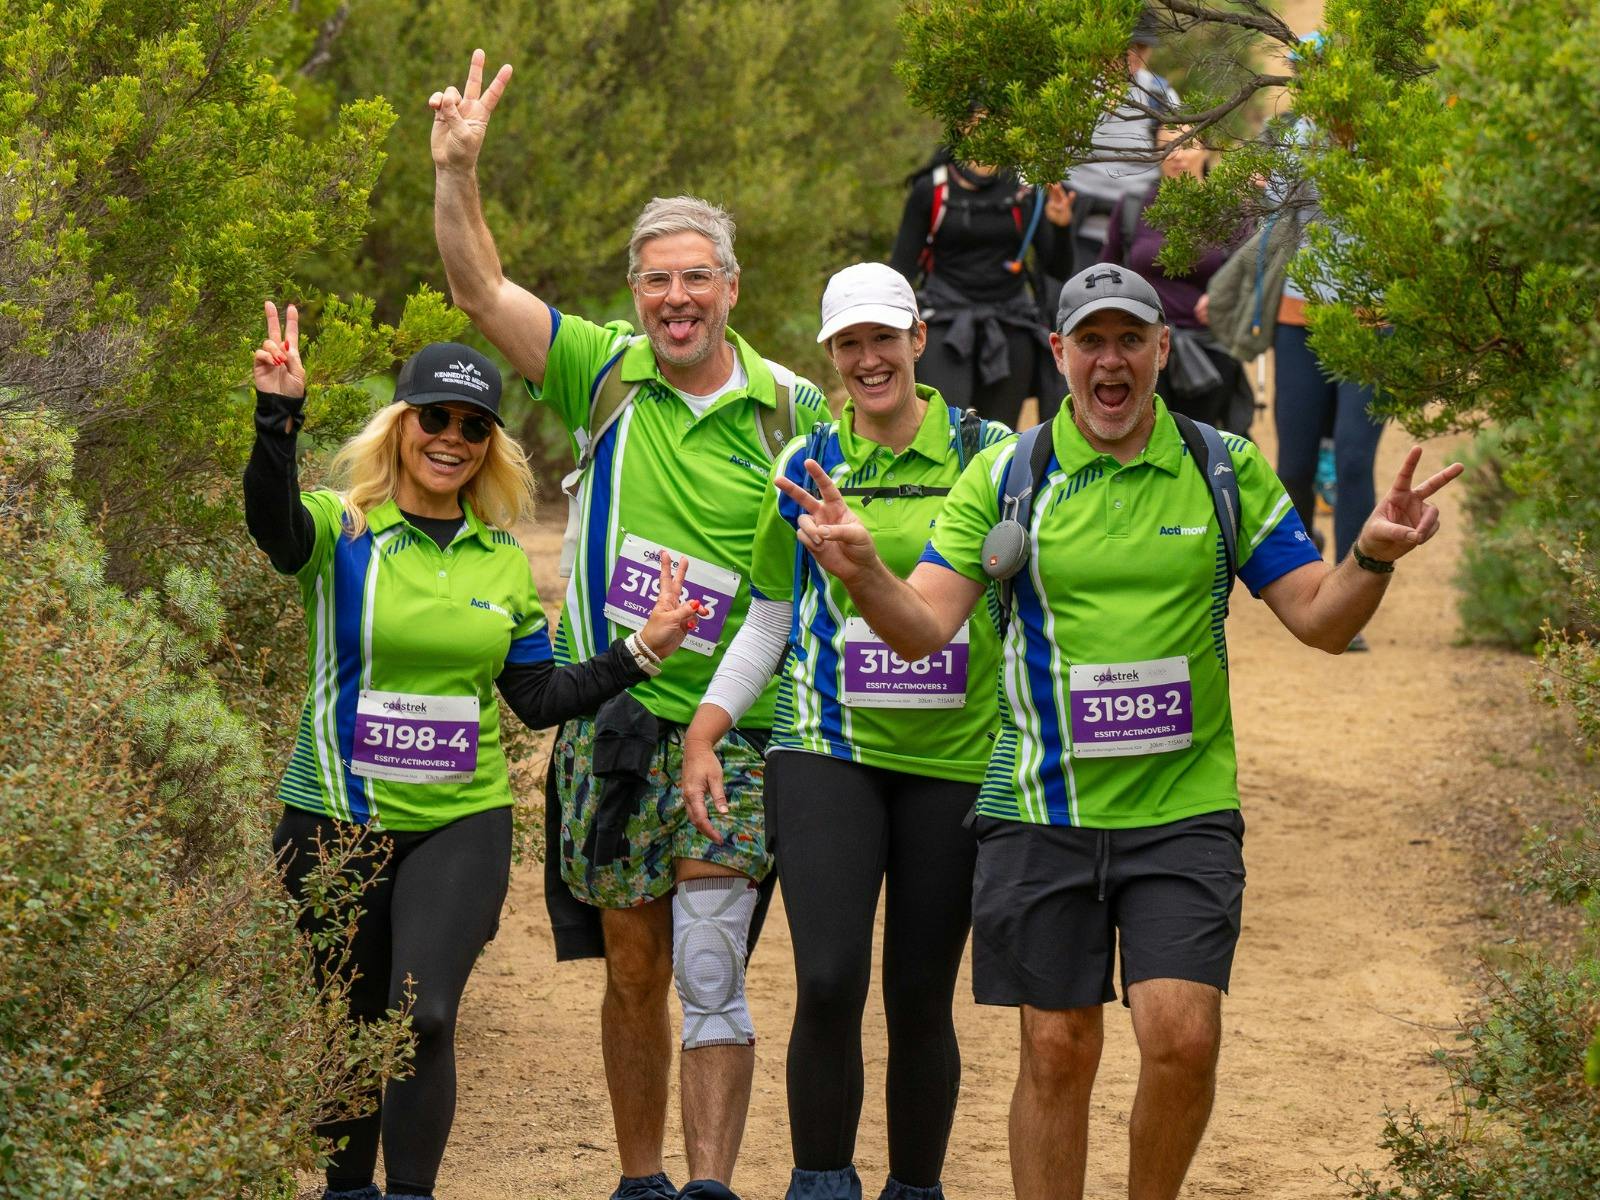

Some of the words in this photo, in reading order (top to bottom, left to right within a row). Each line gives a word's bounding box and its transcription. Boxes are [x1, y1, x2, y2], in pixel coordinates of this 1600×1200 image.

[624, 599, 648, 614] ESSITY
[1093, 669, 1139, 682] coastrek
[866, 682, 892, 690] ESSITY
[892, 682, 941, 690] ACTIMOVERS
[383, 702, 427, 713] coastrek
[1083, 690, 1183, 723] 3198-2
[363, 721, 470, 753] 3198-4
[1094, 729, 1121, 738] ESSITY
[1122, 725, 1171, 737] ACTIMOVERS
[1171, 724, 1177, 732] 2
[374, 754, 401, 764] ESSITY
[401, 757, 449, 768] ACTIMOVERS
